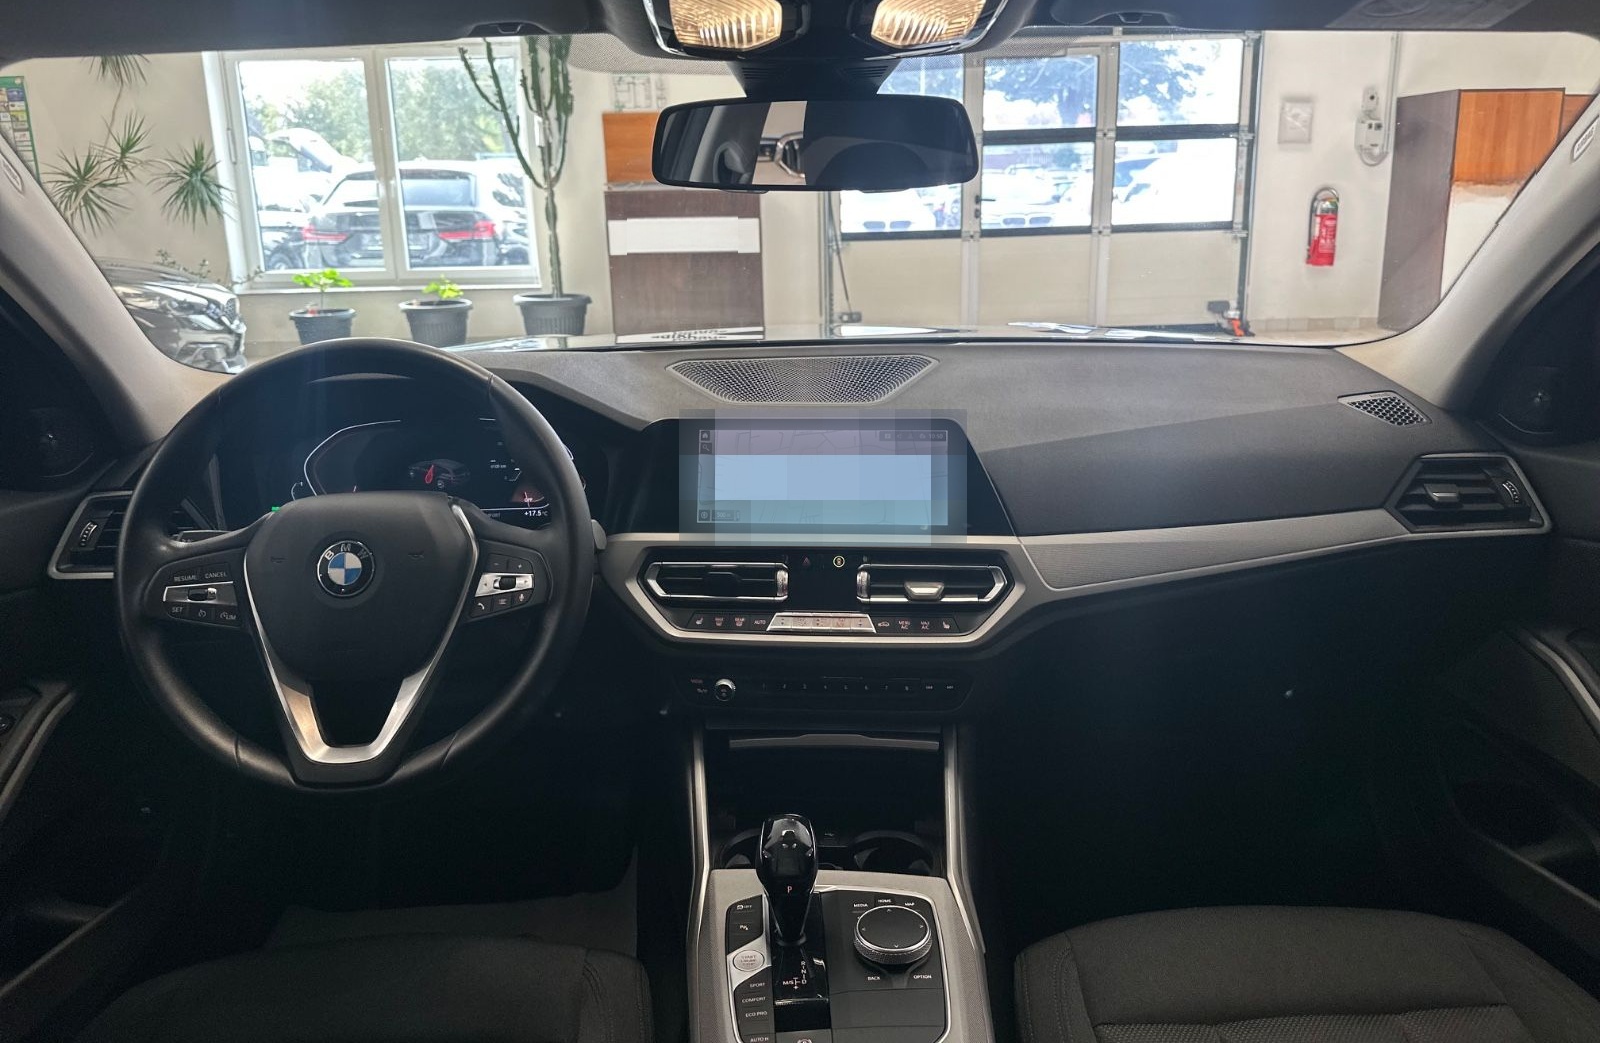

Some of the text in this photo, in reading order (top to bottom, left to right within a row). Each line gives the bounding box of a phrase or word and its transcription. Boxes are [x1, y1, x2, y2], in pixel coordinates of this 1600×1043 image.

[324, 543, 369, 561] BMW
[173, 571, 227, 582] RESUME CANCEL
[787, 885, 793, 894] P
